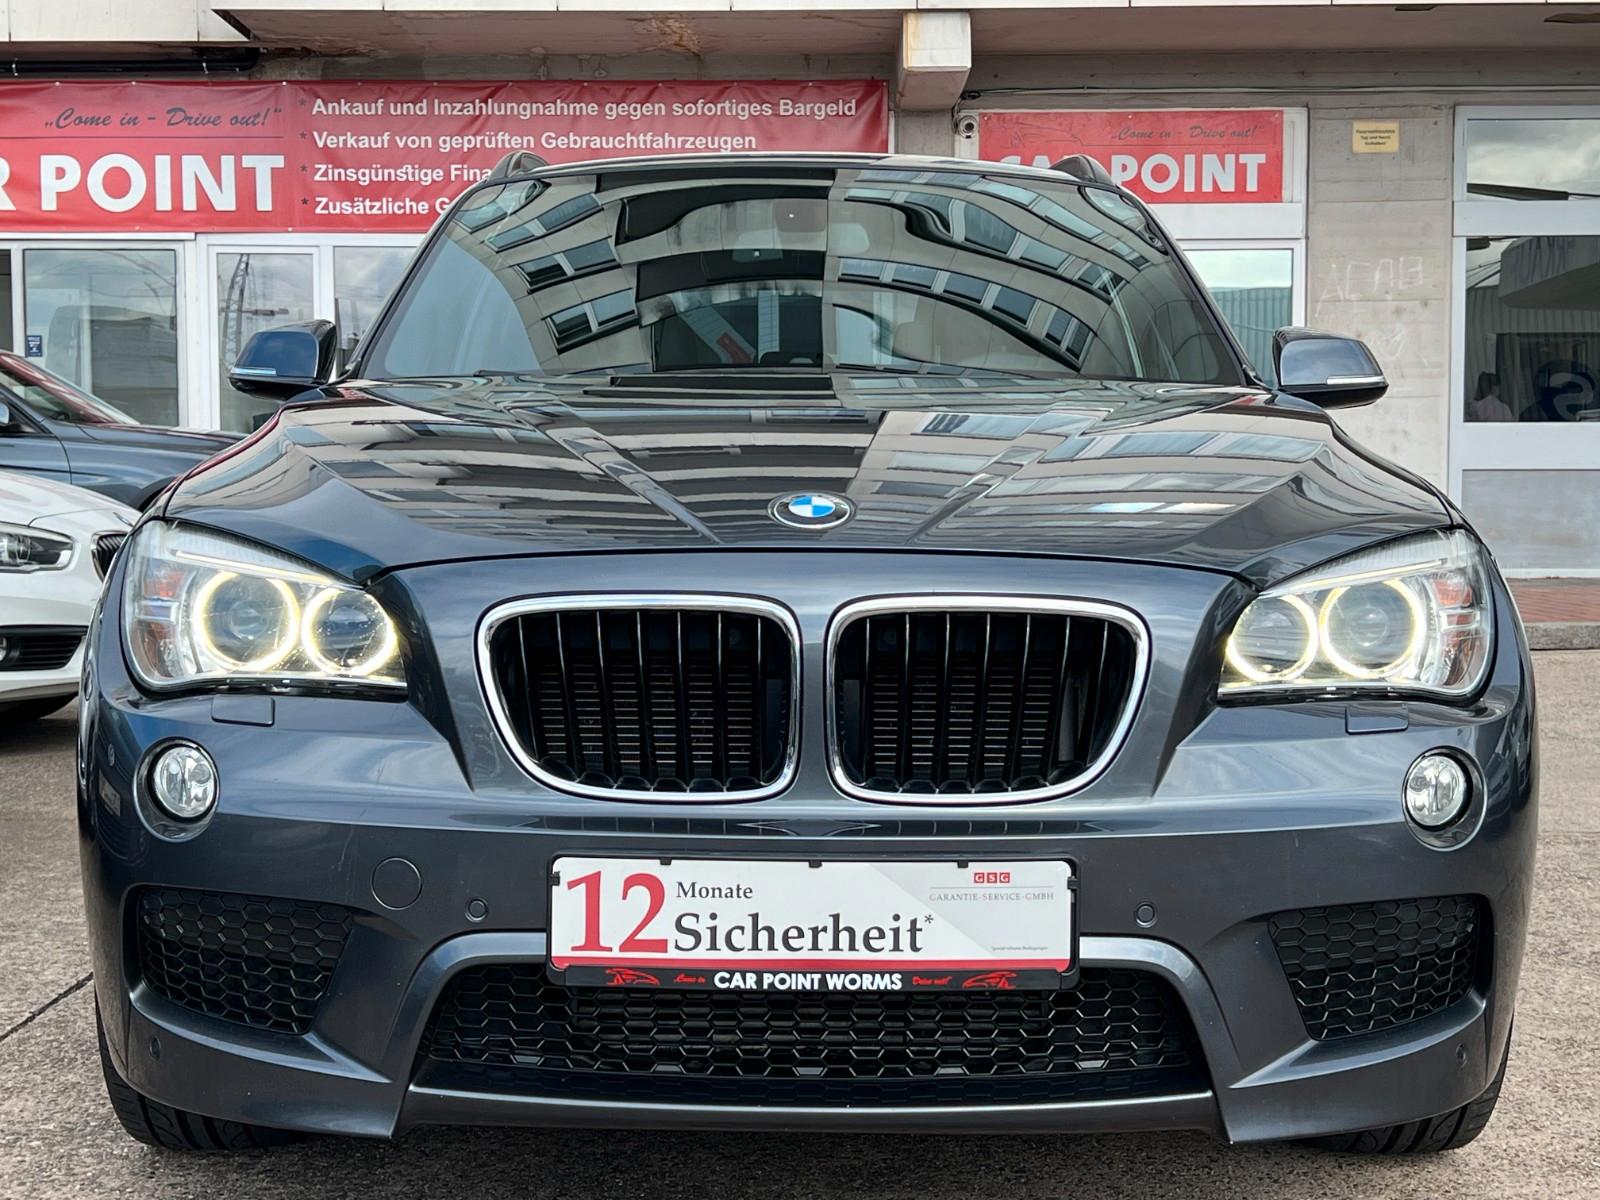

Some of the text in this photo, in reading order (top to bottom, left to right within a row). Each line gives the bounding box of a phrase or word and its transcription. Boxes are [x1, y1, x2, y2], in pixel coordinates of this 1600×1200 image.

[119, 112, 141, 127] in
[166, 107, 223, 127] Drive
[312, 98, 857, 121] Ankauf und Inzahlungnahme gegen sofortiges Bargeld
[312, 131, 757, 153] Verkauf von geprüften Gebrauchtfahrzeugen
[1159, 130, 1172, 140] in
[1188, 124, 1226, 139] Drive
[40, 152, 286, 213] POINT
[313, 163, 492, 186] Zinsgünstige Fina
[1111, 153, 1267, 194] POINT
[314, 197, 430, 215] Zusätzliche
[973, 872, 1011, 883] GSG
[676, 881, 754, 899] Monate
[566, 869, 669, 955] 12
[713, 971, 903, 991] CAR POINT WORMS
